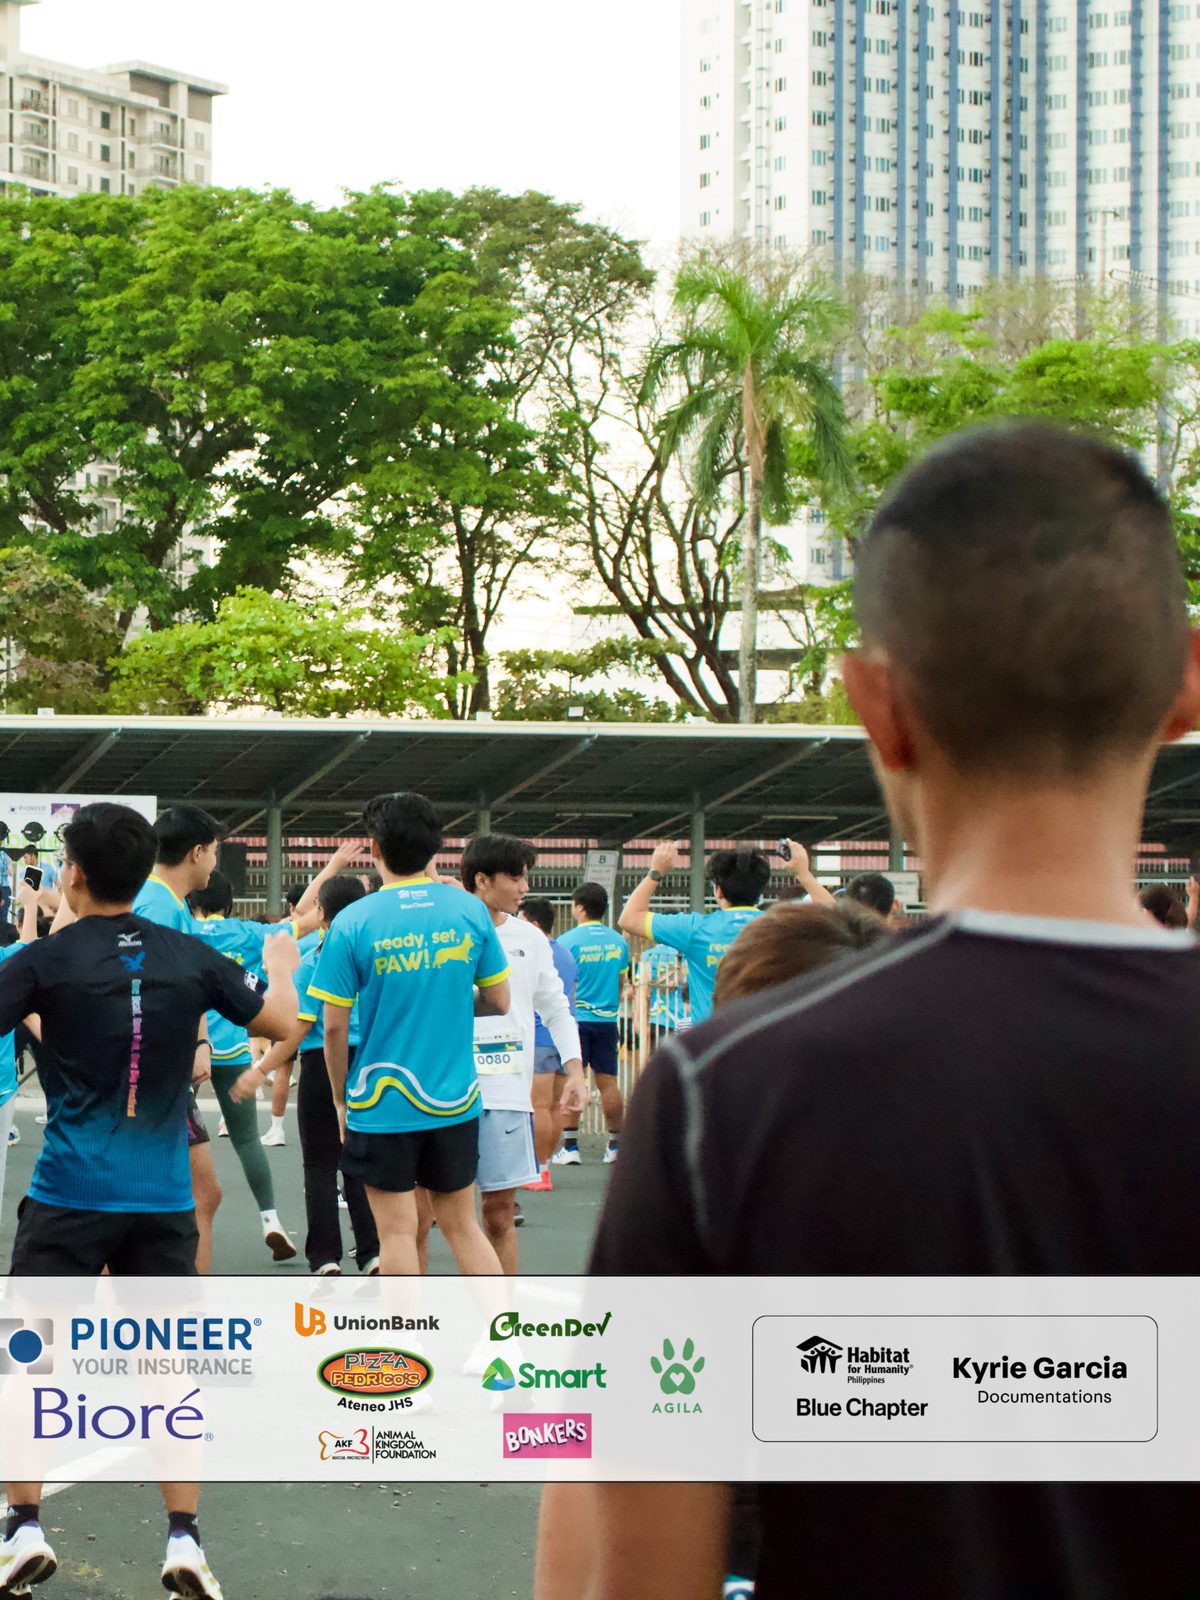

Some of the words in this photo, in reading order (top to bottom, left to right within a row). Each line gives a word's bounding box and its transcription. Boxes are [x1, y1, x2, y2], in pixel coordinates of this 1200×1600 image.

[598, 855, 607, 865] B
[373, 931, 429, 953] ready,
[374, 948, 431, 976] PAW!
[477, 1053, 511, 1065] 0080
